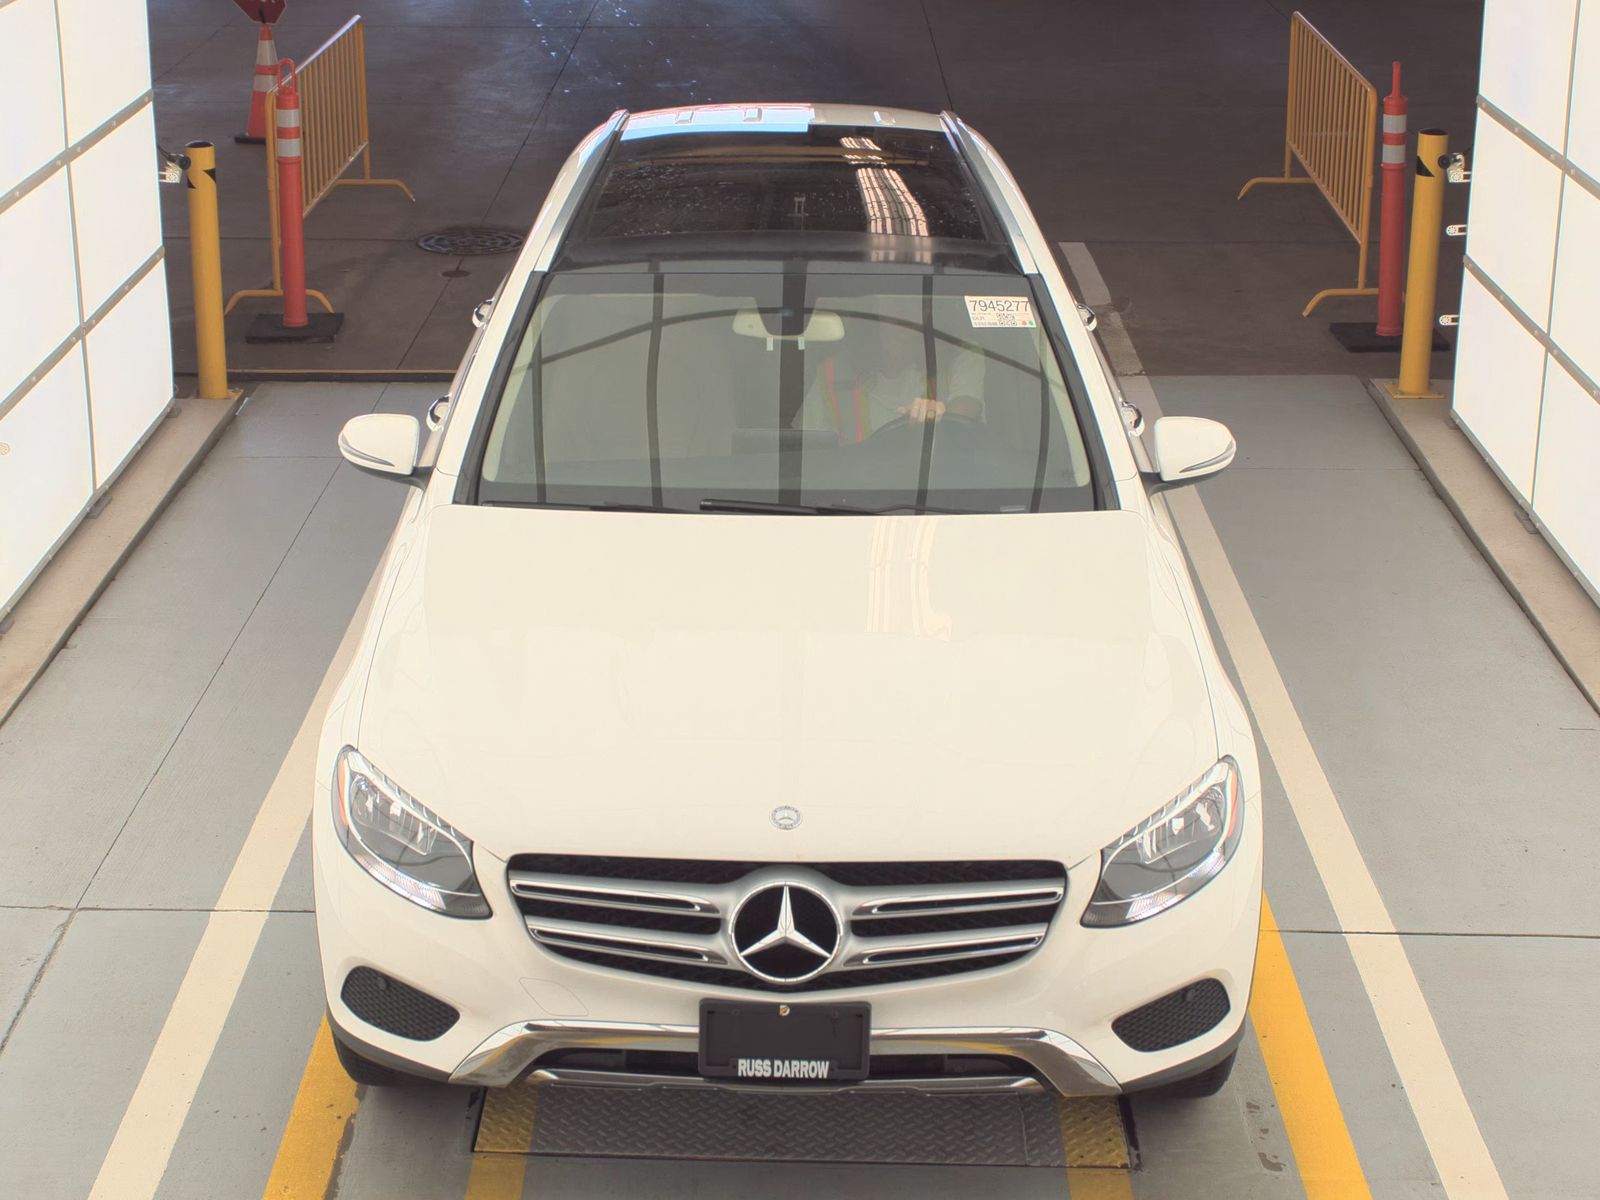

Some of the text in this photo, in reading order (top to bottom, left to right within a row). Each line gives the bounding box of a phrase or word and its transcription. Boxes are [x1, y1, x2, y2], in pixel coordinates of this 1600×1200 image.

[969, 300, 1030, 312] 7945277
[738, 1058, 830, 1079] RUSS DARROW
